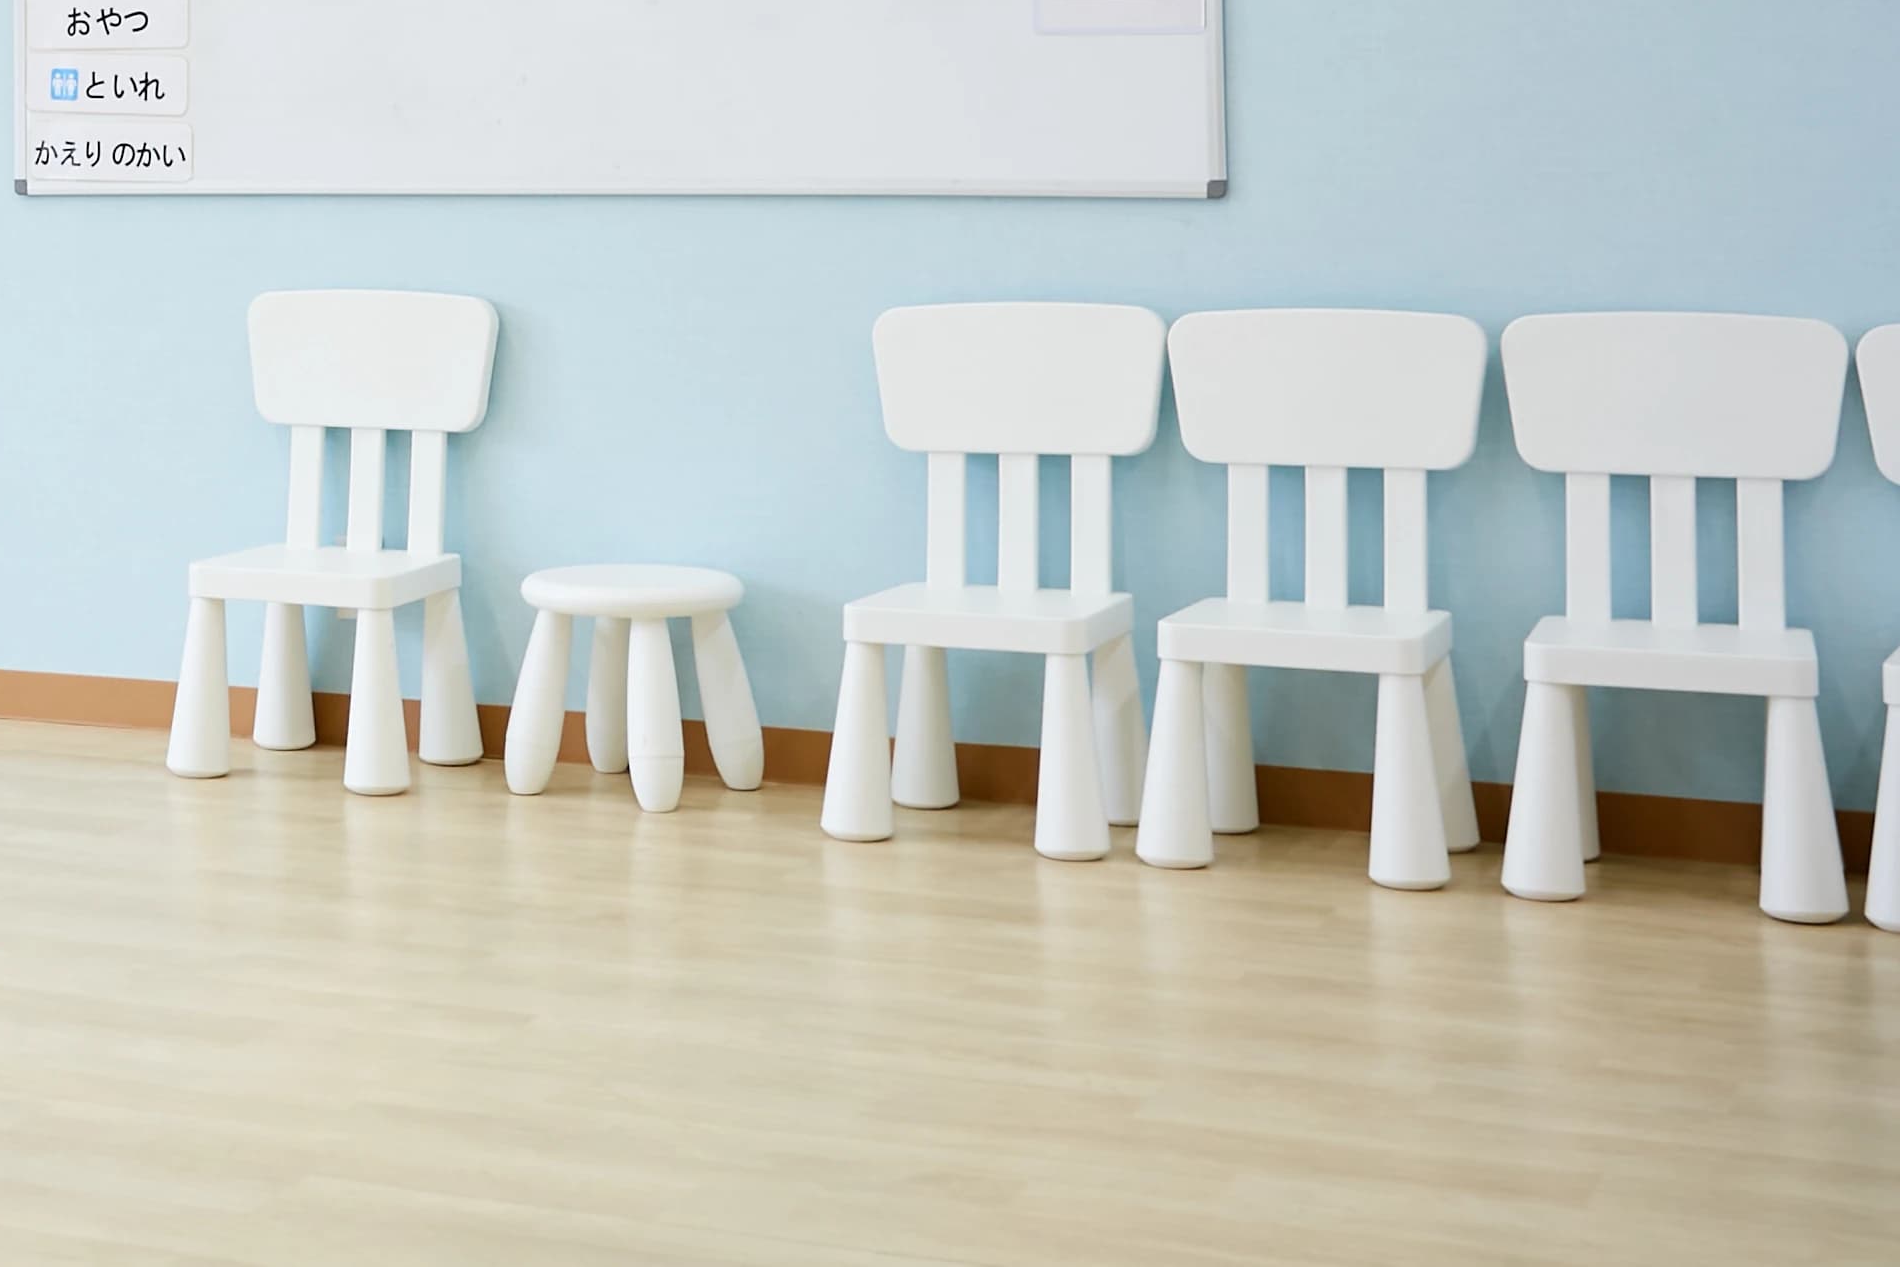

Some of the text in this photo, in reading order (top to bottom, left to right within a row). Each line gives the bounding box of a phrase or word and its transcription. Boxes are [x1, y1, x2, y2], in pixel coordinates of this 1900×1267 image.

[66, 6, 149, 36] おやつ
[85, 71, 165, 101] といれ
